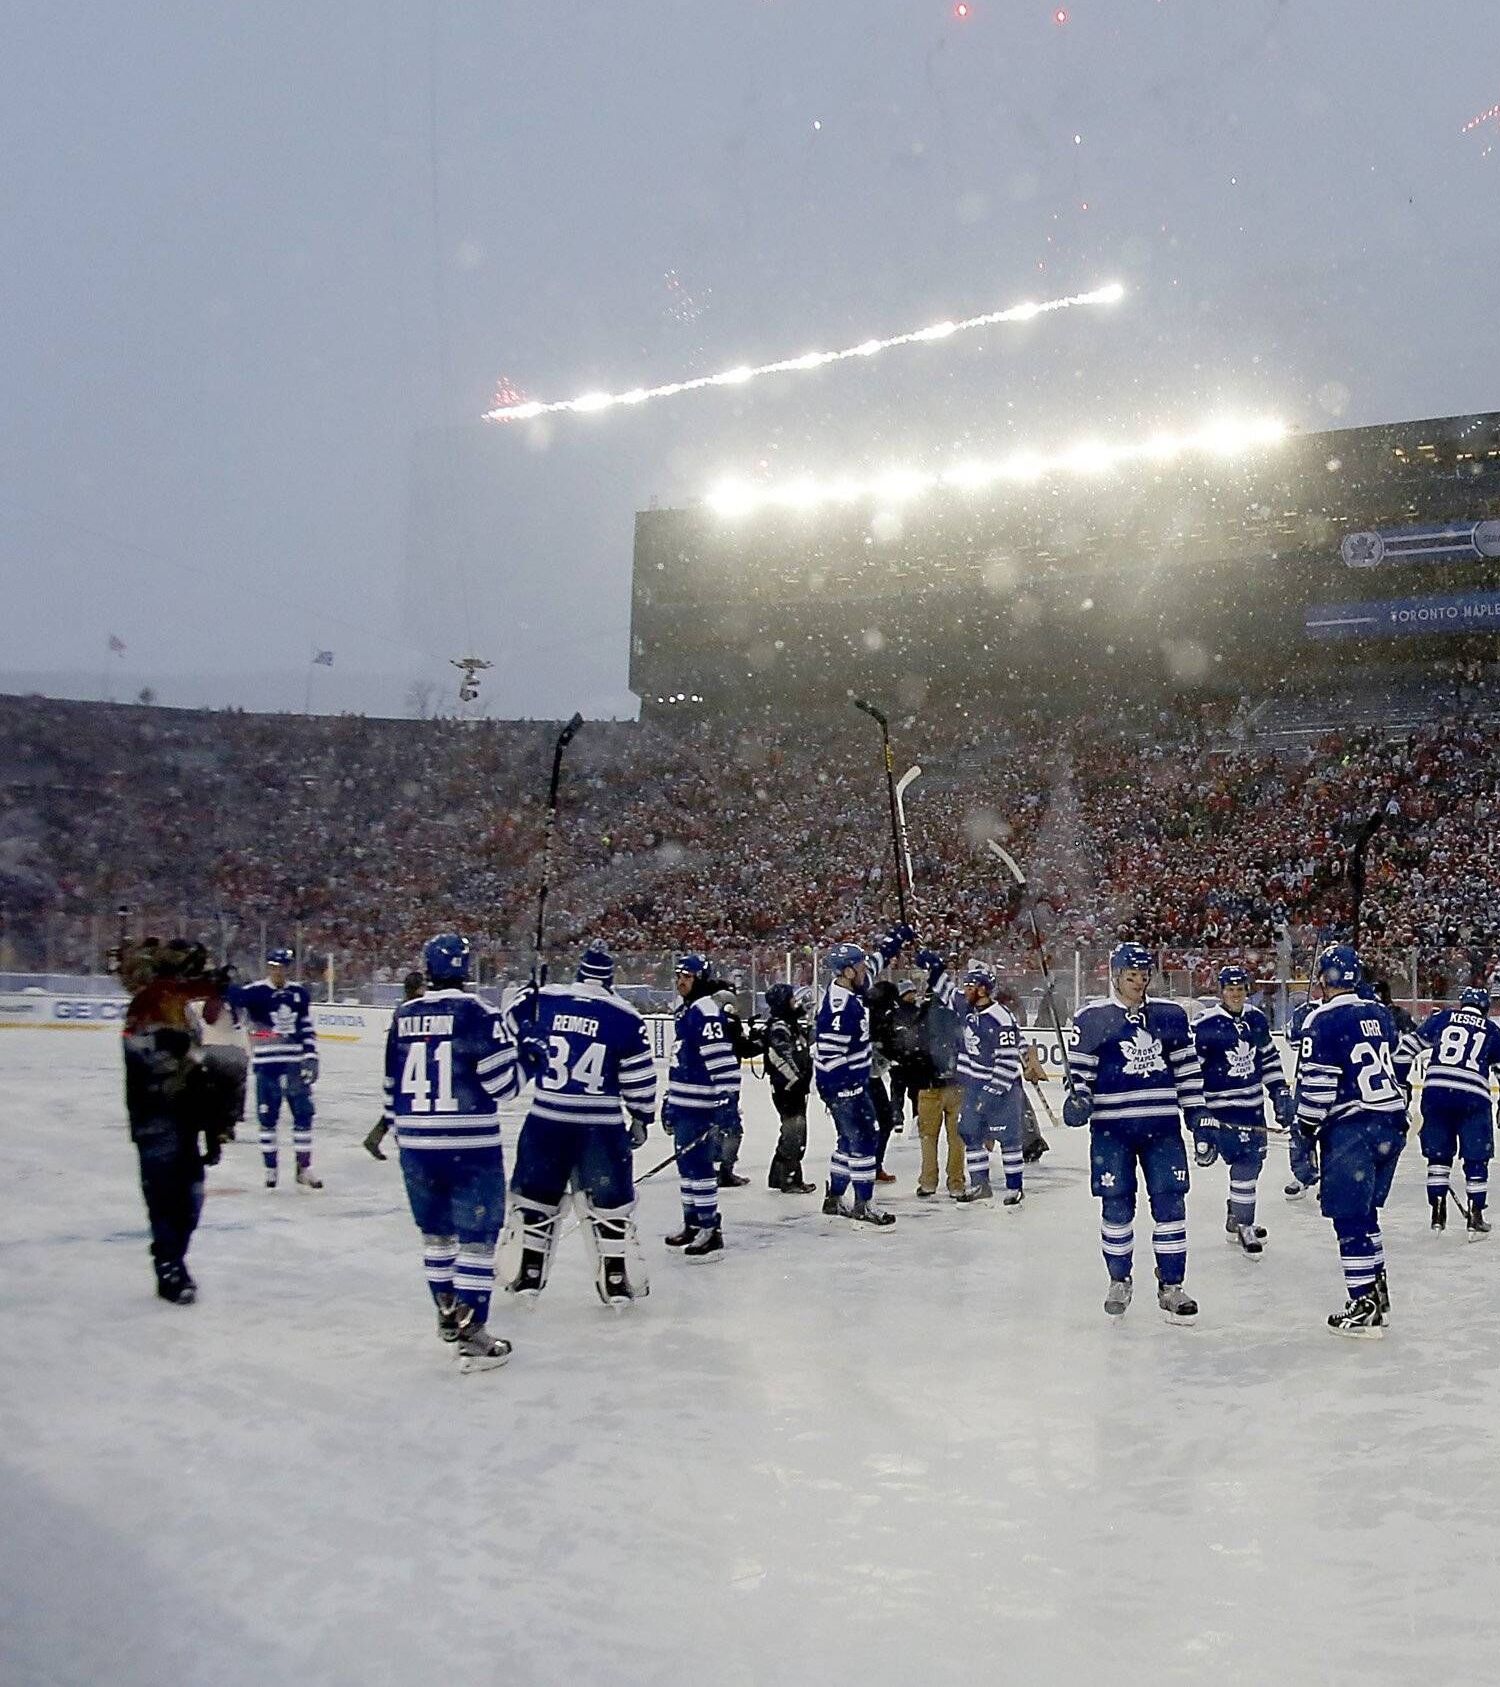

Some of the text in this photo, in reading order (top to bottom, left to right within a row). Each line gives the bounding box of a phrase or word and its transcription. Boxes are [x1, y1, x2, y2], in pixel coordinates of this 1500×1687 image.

[1390, 606, 1458, 623] TORONTO
[552, 1014, 599, 1038] REIMER
[831, 1015, 841, 1031] 4
[1359, 1019, 1382, 1037] ORR
[1449, 1011, 1487, 1030] KESSEL
[655, 1010, 664, 1058] Reebok
[702, 1022, 724, 1040] 43
[999, 1031, 1016, 1046] 29
[1438, 1025, 1487, 1072] 81
[541, 1035, 607, 1095] 34
[401, 1041, 460, 1112] 41
